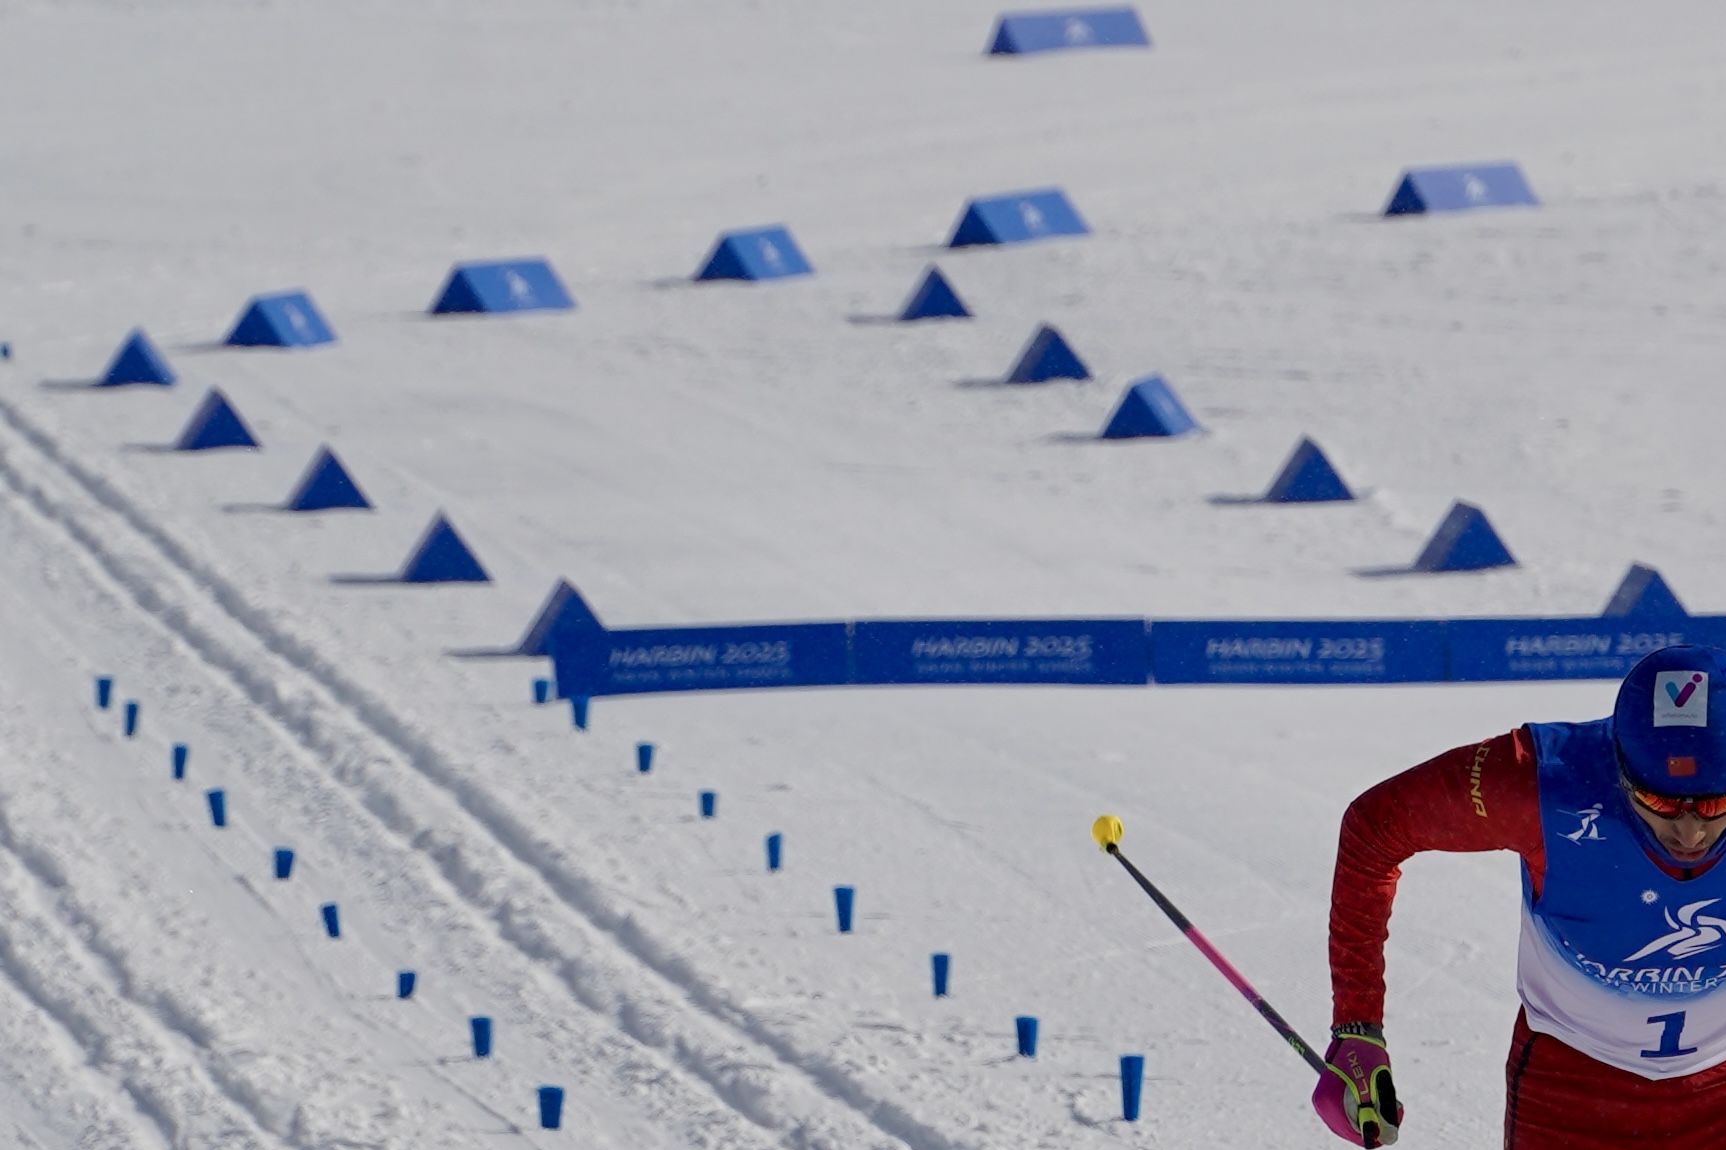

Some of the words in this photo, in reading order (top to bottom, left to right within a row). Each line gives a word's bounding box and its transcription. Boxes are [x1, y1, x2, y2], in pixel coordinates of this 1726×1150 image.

[609, 643, 719, 668] HARBIN
[720, 640, 791, 666] 2025
[911, 636, 1019, 658] HARBIN
[1023, 635, 1094, 661] 2025
[1205, 637, 1313, 659] HARBIN
[1316, 637, 1386, 662] 2025
[1506, 634, 1612, 657] HARBIN
[1470, 746, 1490, 818] CHINA
[1631, 977, 1718, 994] WINTER
[1640, 1010, 1698, 1058] 1
[1346, 1050, 1369, 1096] LEKI
